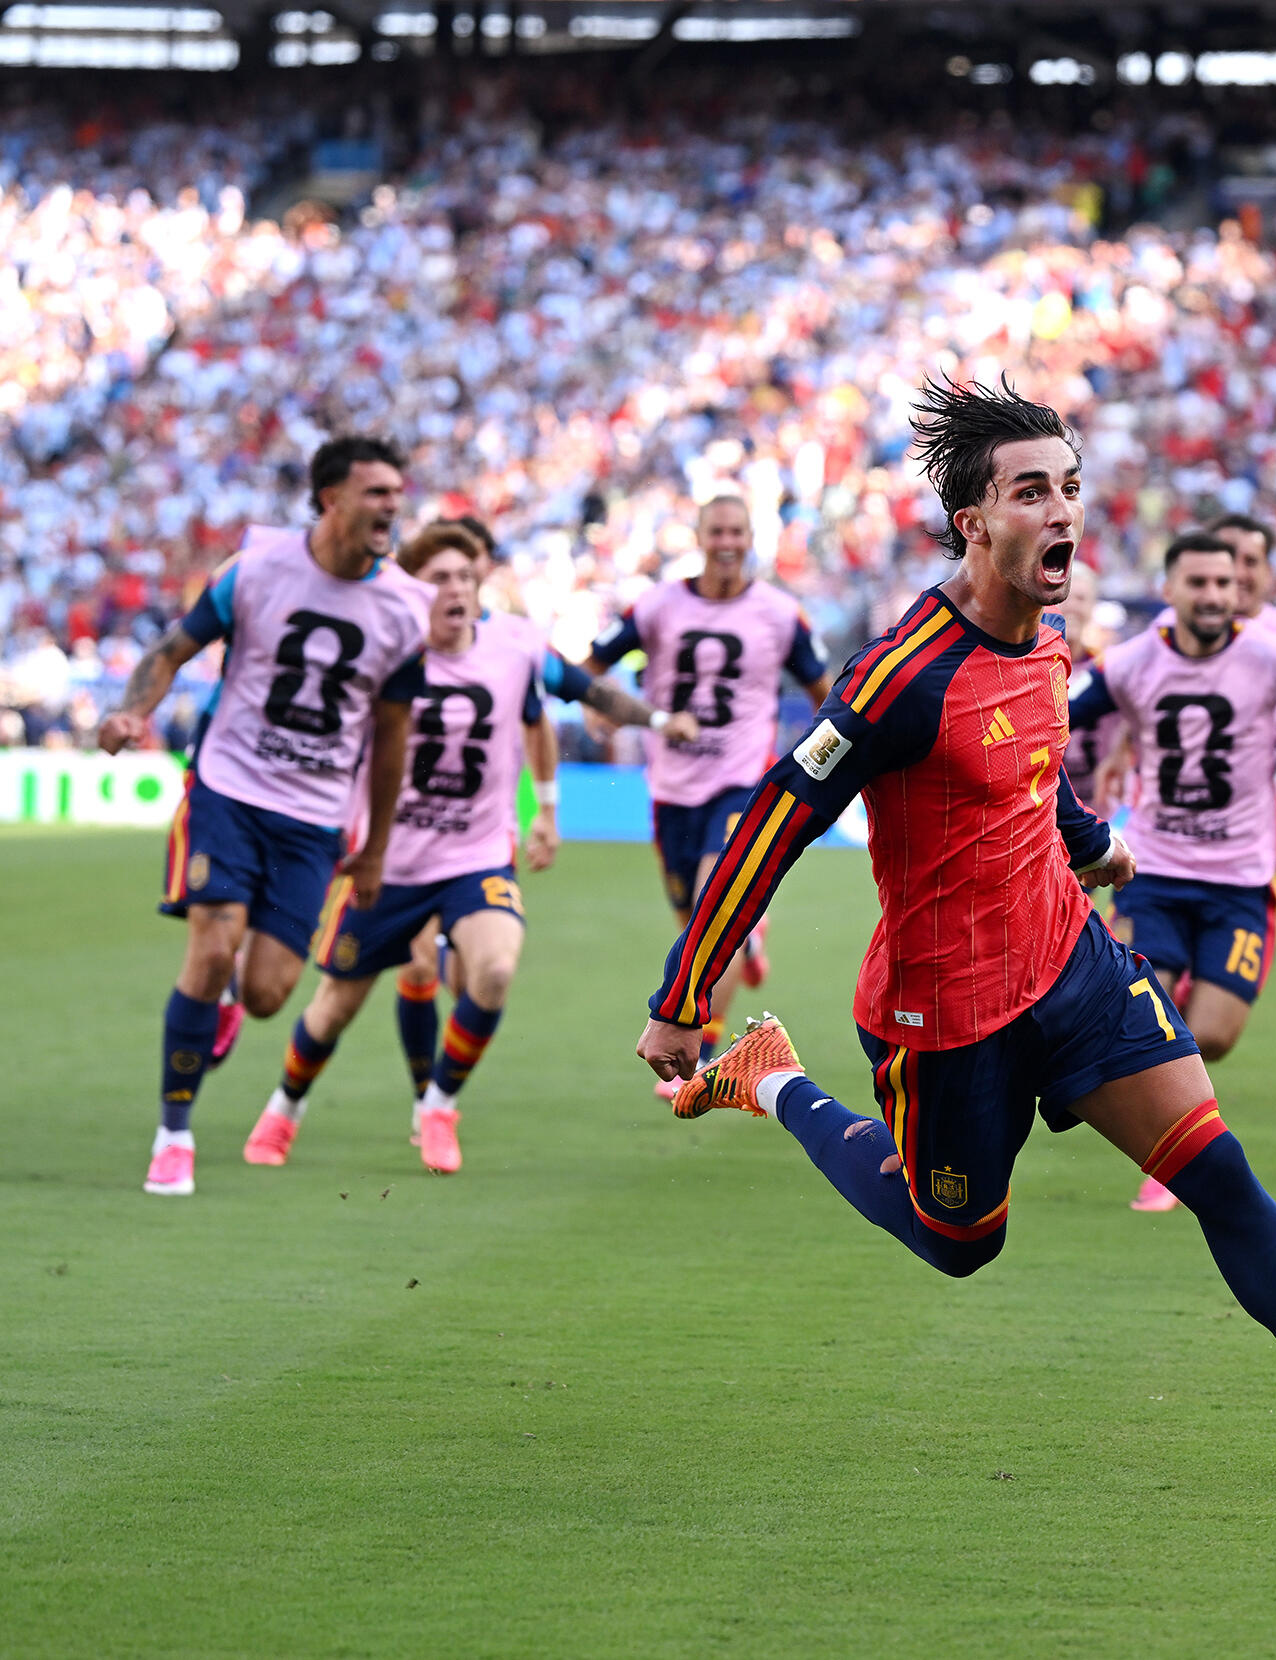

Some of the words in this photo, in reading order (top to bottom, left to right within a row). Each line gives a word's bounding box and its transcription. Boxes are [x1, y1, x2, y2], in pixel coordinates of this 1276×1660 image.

[802, 757, 819, 775] 2026
[1030, 746, 1050, 808] 7
[1225, 928, 1262, 982] 15
[1129, 977, 1176, 1041] 7
